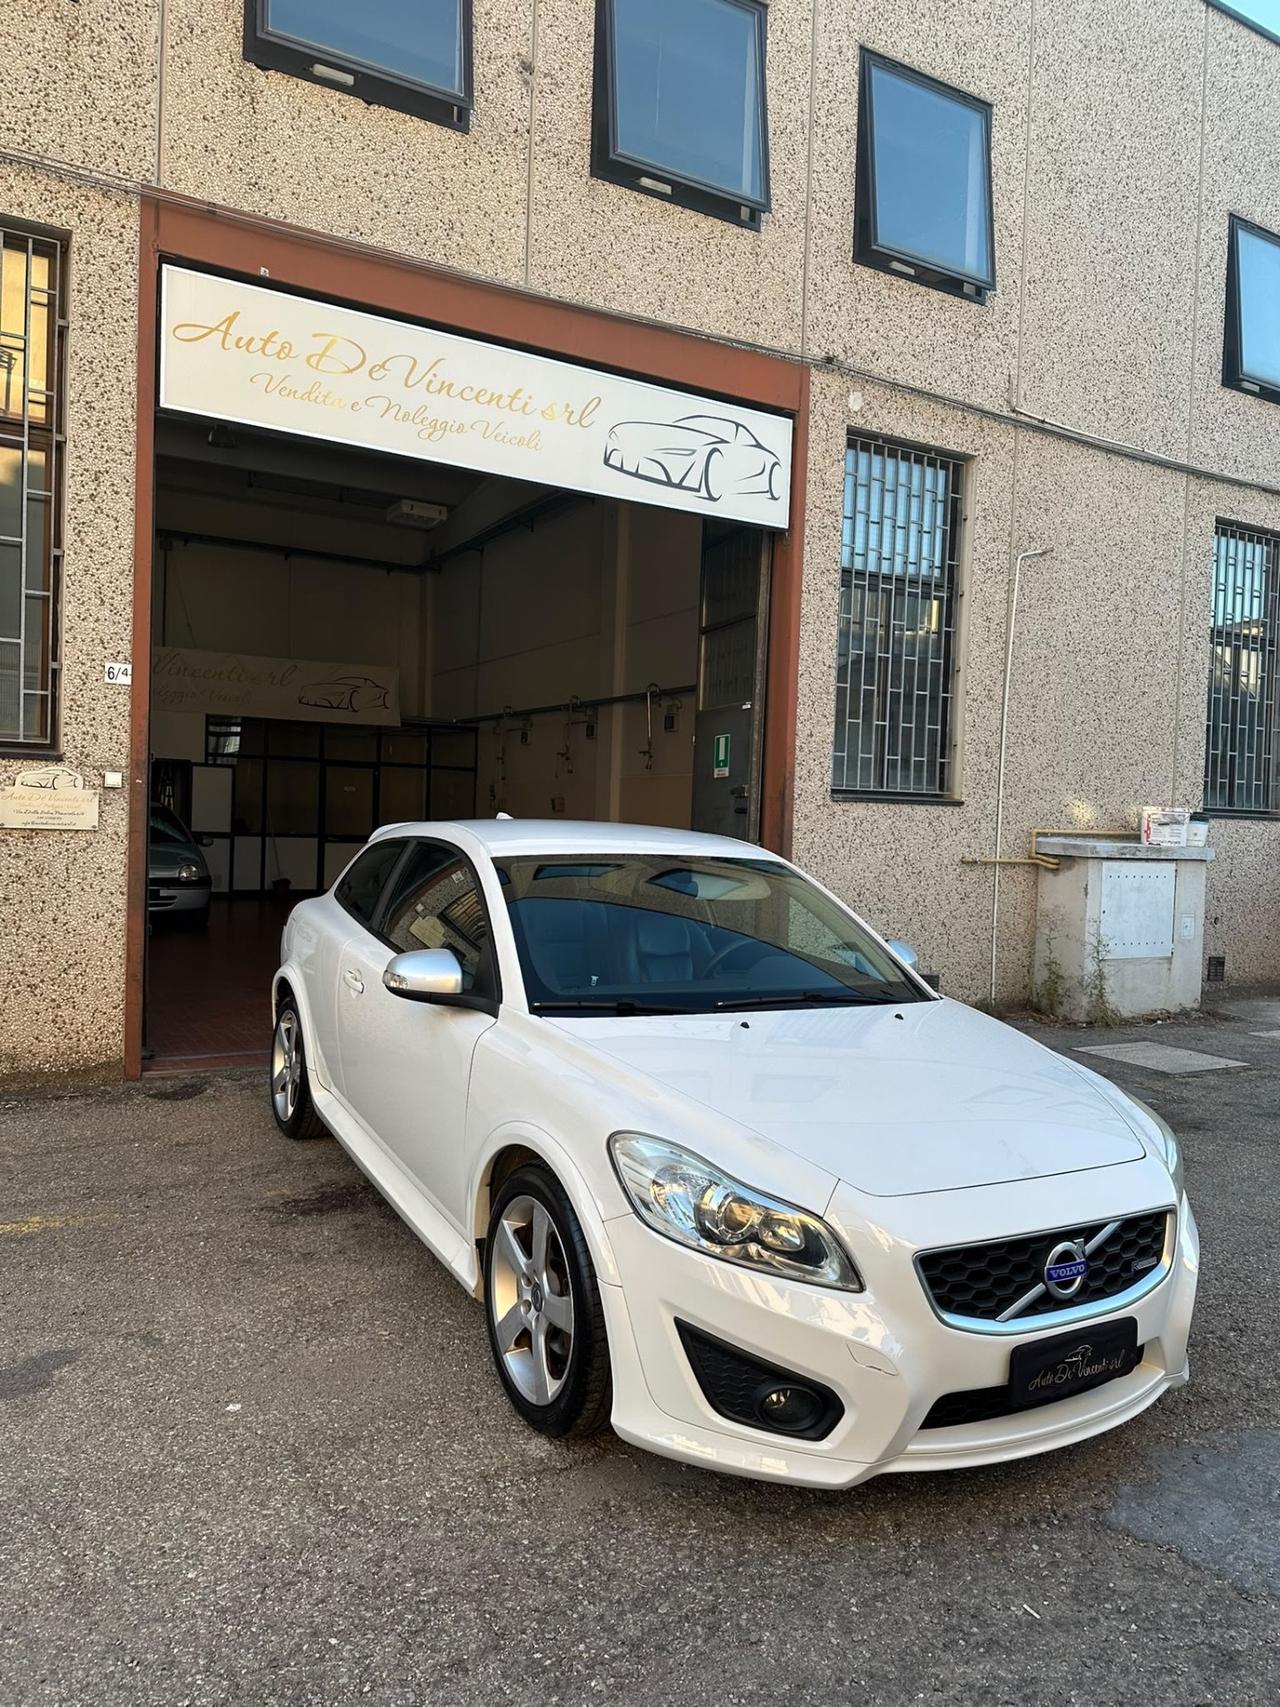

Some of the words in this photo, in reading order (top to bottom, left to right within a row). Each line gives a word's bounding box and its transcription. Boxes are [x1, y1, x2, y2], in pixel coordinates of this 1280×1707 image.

[172, 310, 299, 361] Auto
[305, 332, 388, 382] De
[380, 354, 535, 416] Vincenti
[541, 396, 602, 429] srl
[249, 372, 345, 409] Vendita
[350, 400, 362, 412] e
[364, 395, 468, 442] Noleggio
[470, 419, 543, 451] Veicoli
[107, 666, 129, 681] 6/4
[1051, 1264, 1086, 1279] VOLVO
[1028, 1369, 1054, 1391] Auto
